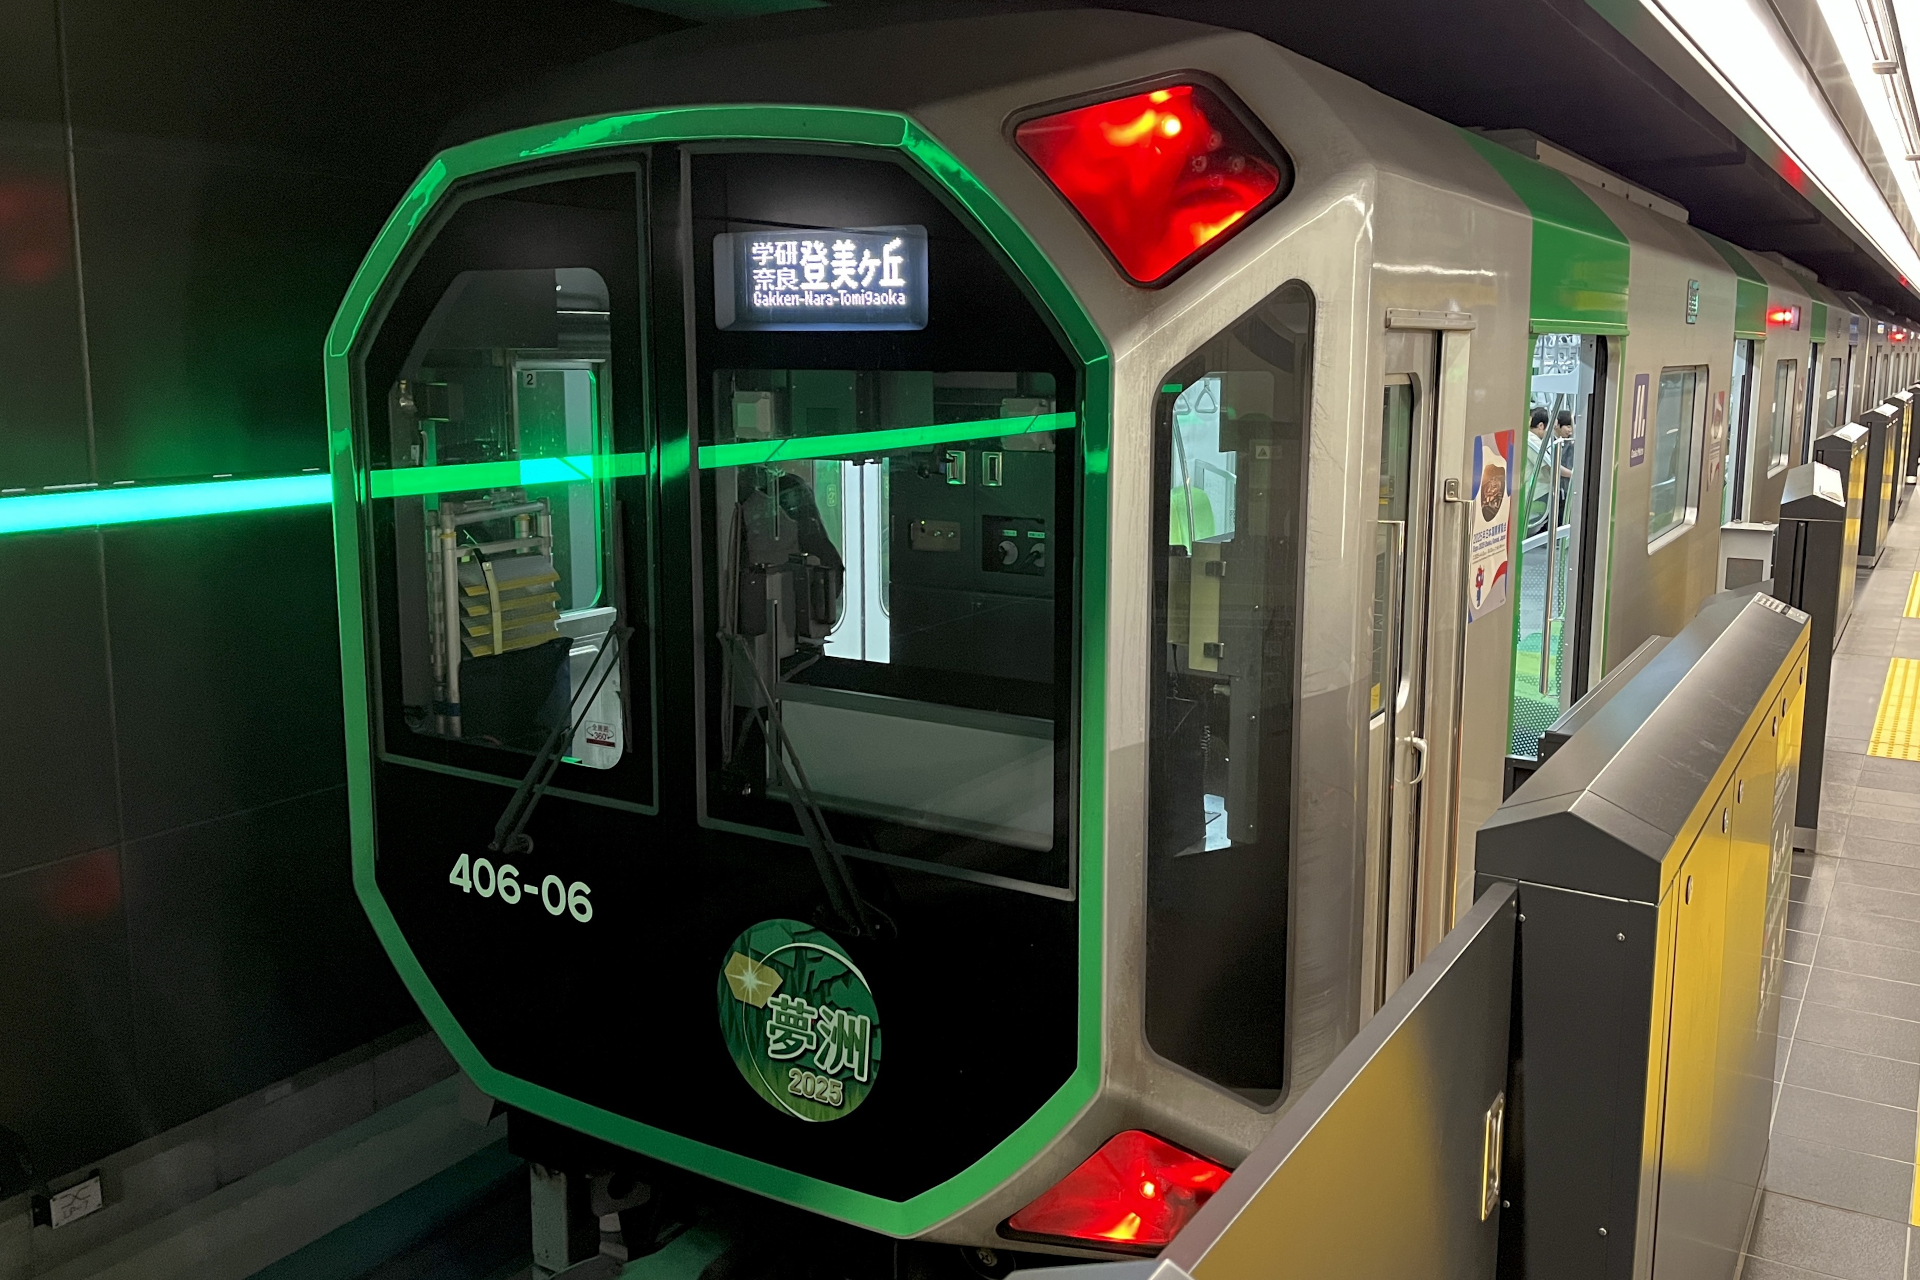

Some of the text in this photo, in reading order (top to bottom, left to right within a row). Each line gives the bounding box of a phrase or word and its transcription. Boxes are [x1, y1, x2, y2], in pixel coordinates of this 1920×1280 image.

[752, 242, 798, 265] 学研
[752, 267, 799, 291] 奈良
[753, 289, 906, 306] Gakken-Nara-Tomigaoka
[526, 373, 534, 386] 2
[449, 853, 593, 923] 406-06
[766, 994, 870, 1082] 夢洲
[788, 1068, 843, 1106] 2025
